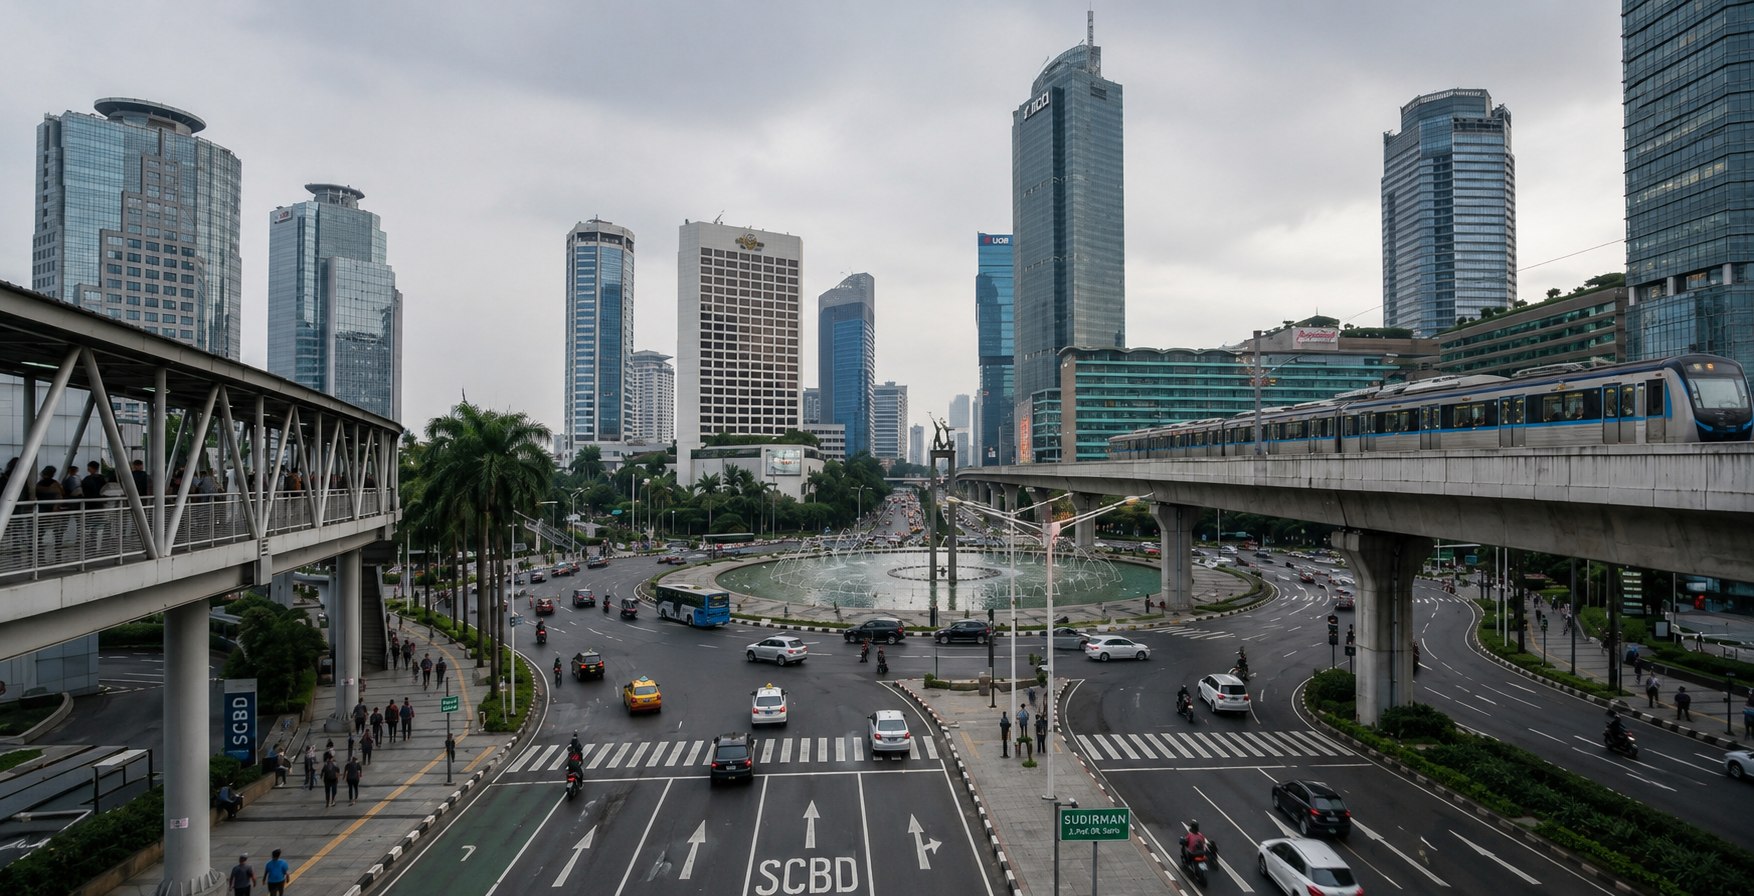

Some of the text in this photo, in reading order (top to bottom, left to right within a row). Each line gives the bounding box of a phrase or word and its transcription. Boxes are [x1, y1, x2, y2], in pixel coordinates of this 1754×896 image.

[232, 697, 248, 745] SCBD
[1064, 814, 1126, 825] SUDIRMAN
[755, 856, 859, 896] SCBD
